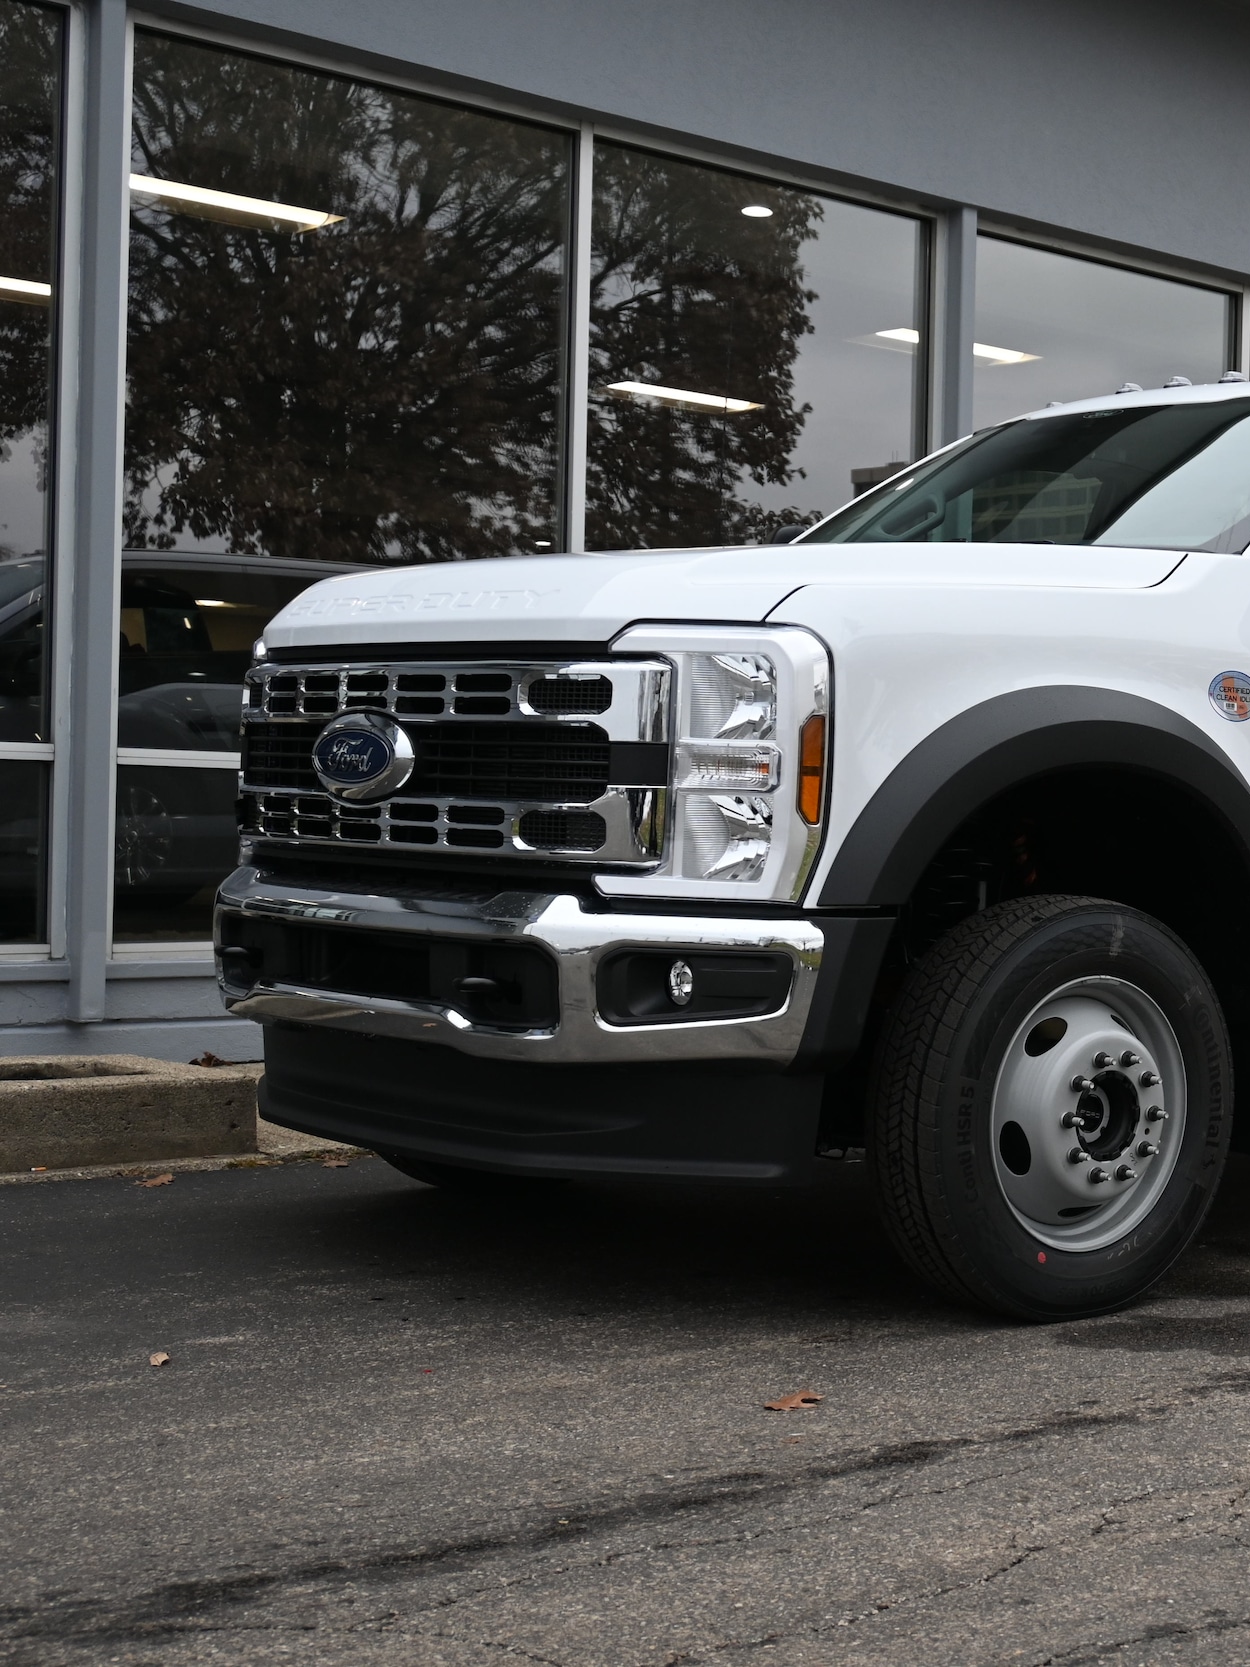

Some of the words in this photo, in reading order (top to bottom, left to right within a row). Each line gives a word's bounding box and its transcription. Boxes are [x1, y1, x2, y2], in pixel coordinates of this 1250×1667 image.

[286, 594, 414, 618] SUPER
[414, 588, 561, 613] DUTY
[1216, 694, 1238, 702] CLEAN
[1219, 685, 1250, 695] CERTIFIED
[327, 737, 374, 772] Ford
[1193, 1003, 1223, 1148] Continental
[960, 1086, 975, 1099] 5
[957, 1103, 973, 1146] HSR
